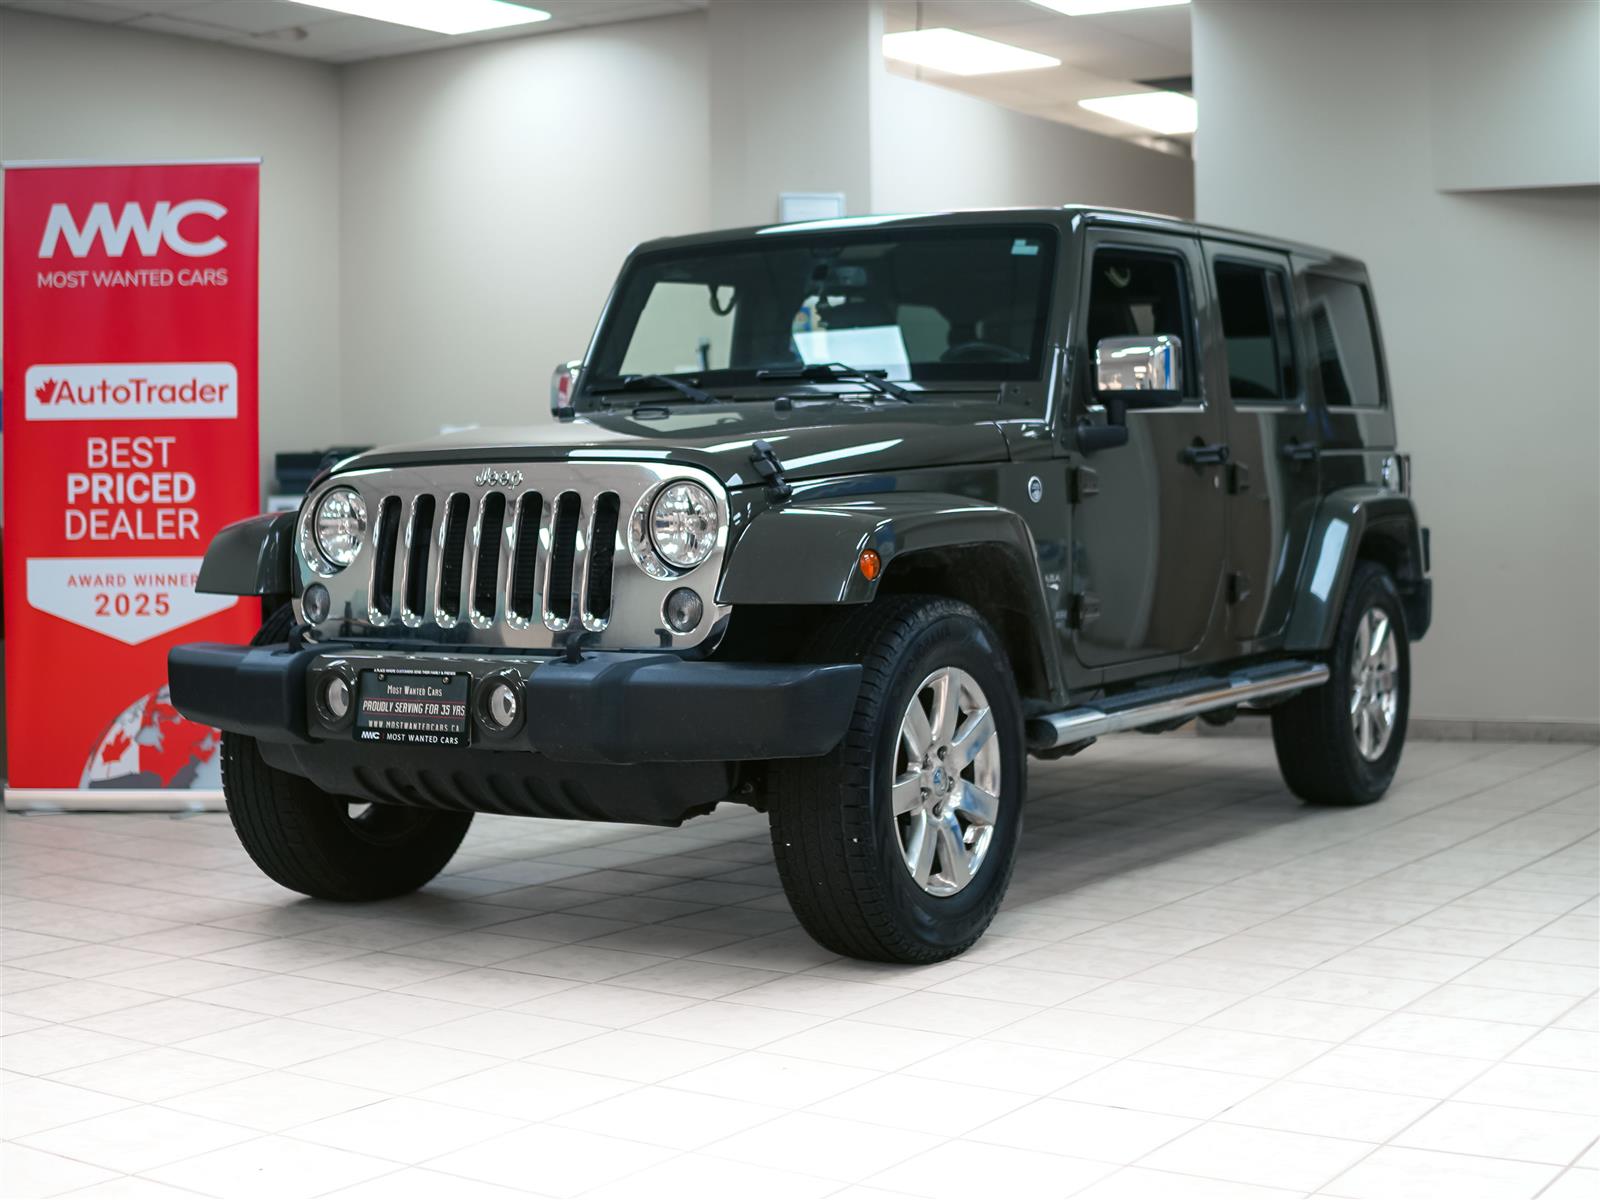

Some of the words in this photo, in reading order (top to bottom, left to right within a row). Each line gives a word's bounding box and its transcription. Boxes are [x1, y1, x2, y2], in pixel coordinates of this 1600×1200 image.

[38, 199, 228, 259] MWC
[37, 271, 88, 288] MOST
[92, 269, 174, 288] WANTED
[177, 268, 229, 286] CARS
[54, 378, 229, 405] AutoTrader
[87, 436, 176, 469] BEST
[66, 472, 196, 504] PRICED
[475, 467, 524, 490] Jeep
[65, 508, 200, 540] DEALER
[67, 574, 127, 587] AWARD
[95, 593, 170, 616] 2025
[362, 700, 393, 712] PROUDLY
[394, 702, 423, 714] SERVING
[424, 703, 439, 715] FOR
[440, 704, 451, 716] 35
[452, 705, 466, 717] YRS
[368, 720, 460, 732] WWWMOSTWANTEDCARSCA
[386, 733, 406, 741] MOST
[407, 734, 438, 744] WANTED
[440, 736, 459, 745] CARS
